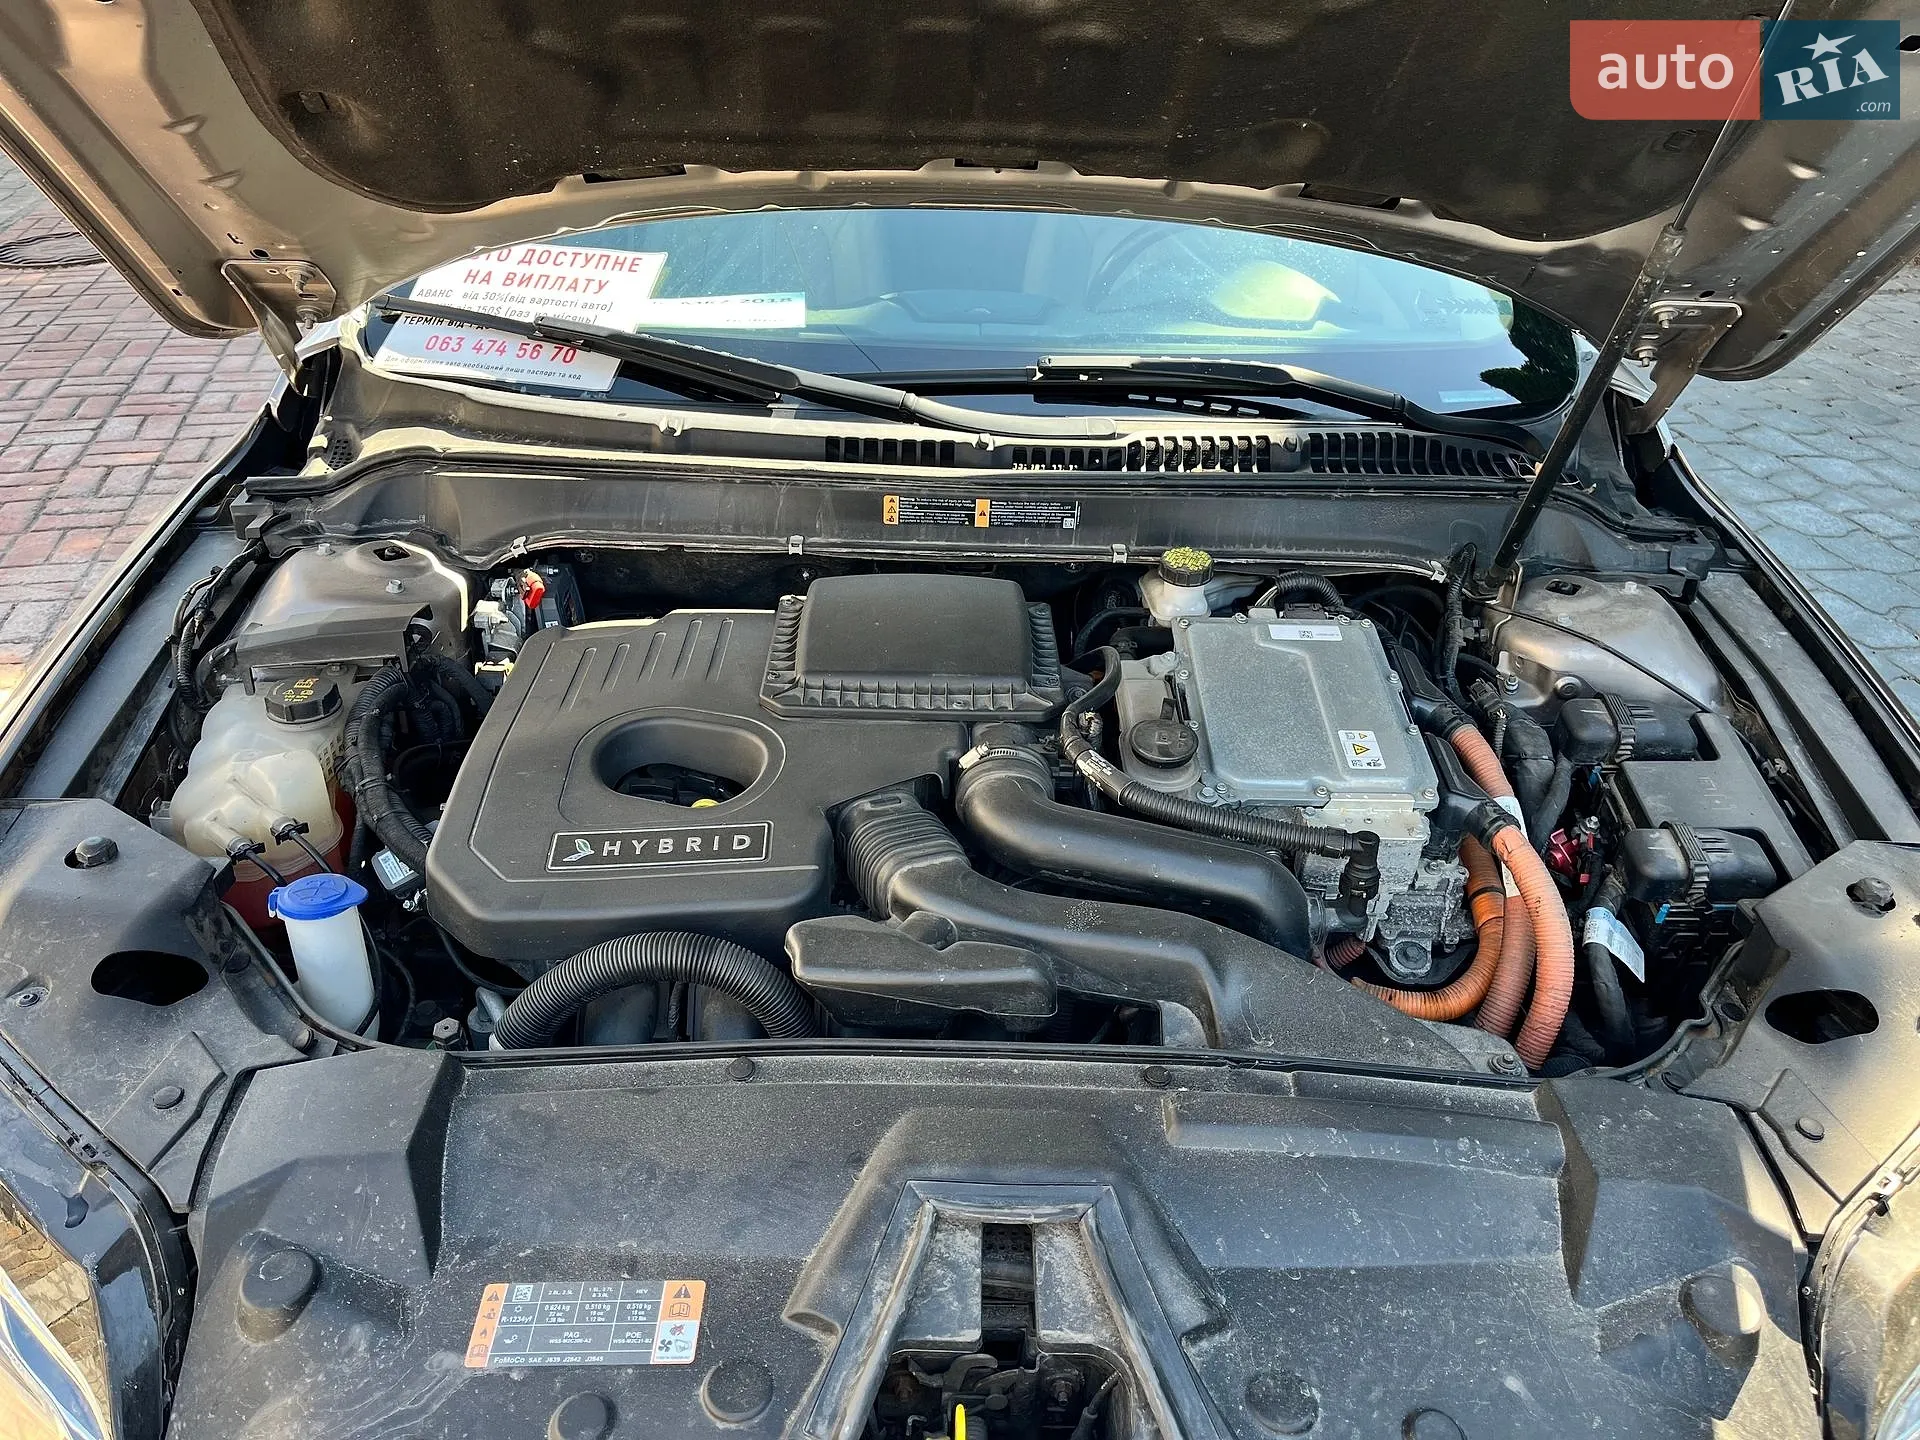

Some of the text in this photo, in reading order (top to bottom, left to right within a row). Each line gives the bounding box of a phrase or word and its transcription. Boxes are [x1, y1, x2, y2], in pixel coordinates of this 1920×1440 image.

[518, 248, 643, 273] ДОСТУПНЕ
[463, 269, 609, 295] НА ВИПЛАТУ
[416, 288, 454, 299] АВАНС
[462, 290, 479, 300] від
[529, 296, 578, 308] вартості
[581, 301, 614, 313] авто)
[504, 306, 531, 318] (раз
[403, 314, 445, 326] ТЕРМІН
[424, 334, 577, 364] 063 474 56 70
[602, 834, 751, 857] HYBRID
[501, 1315, 533, 1324] R-1234yf
